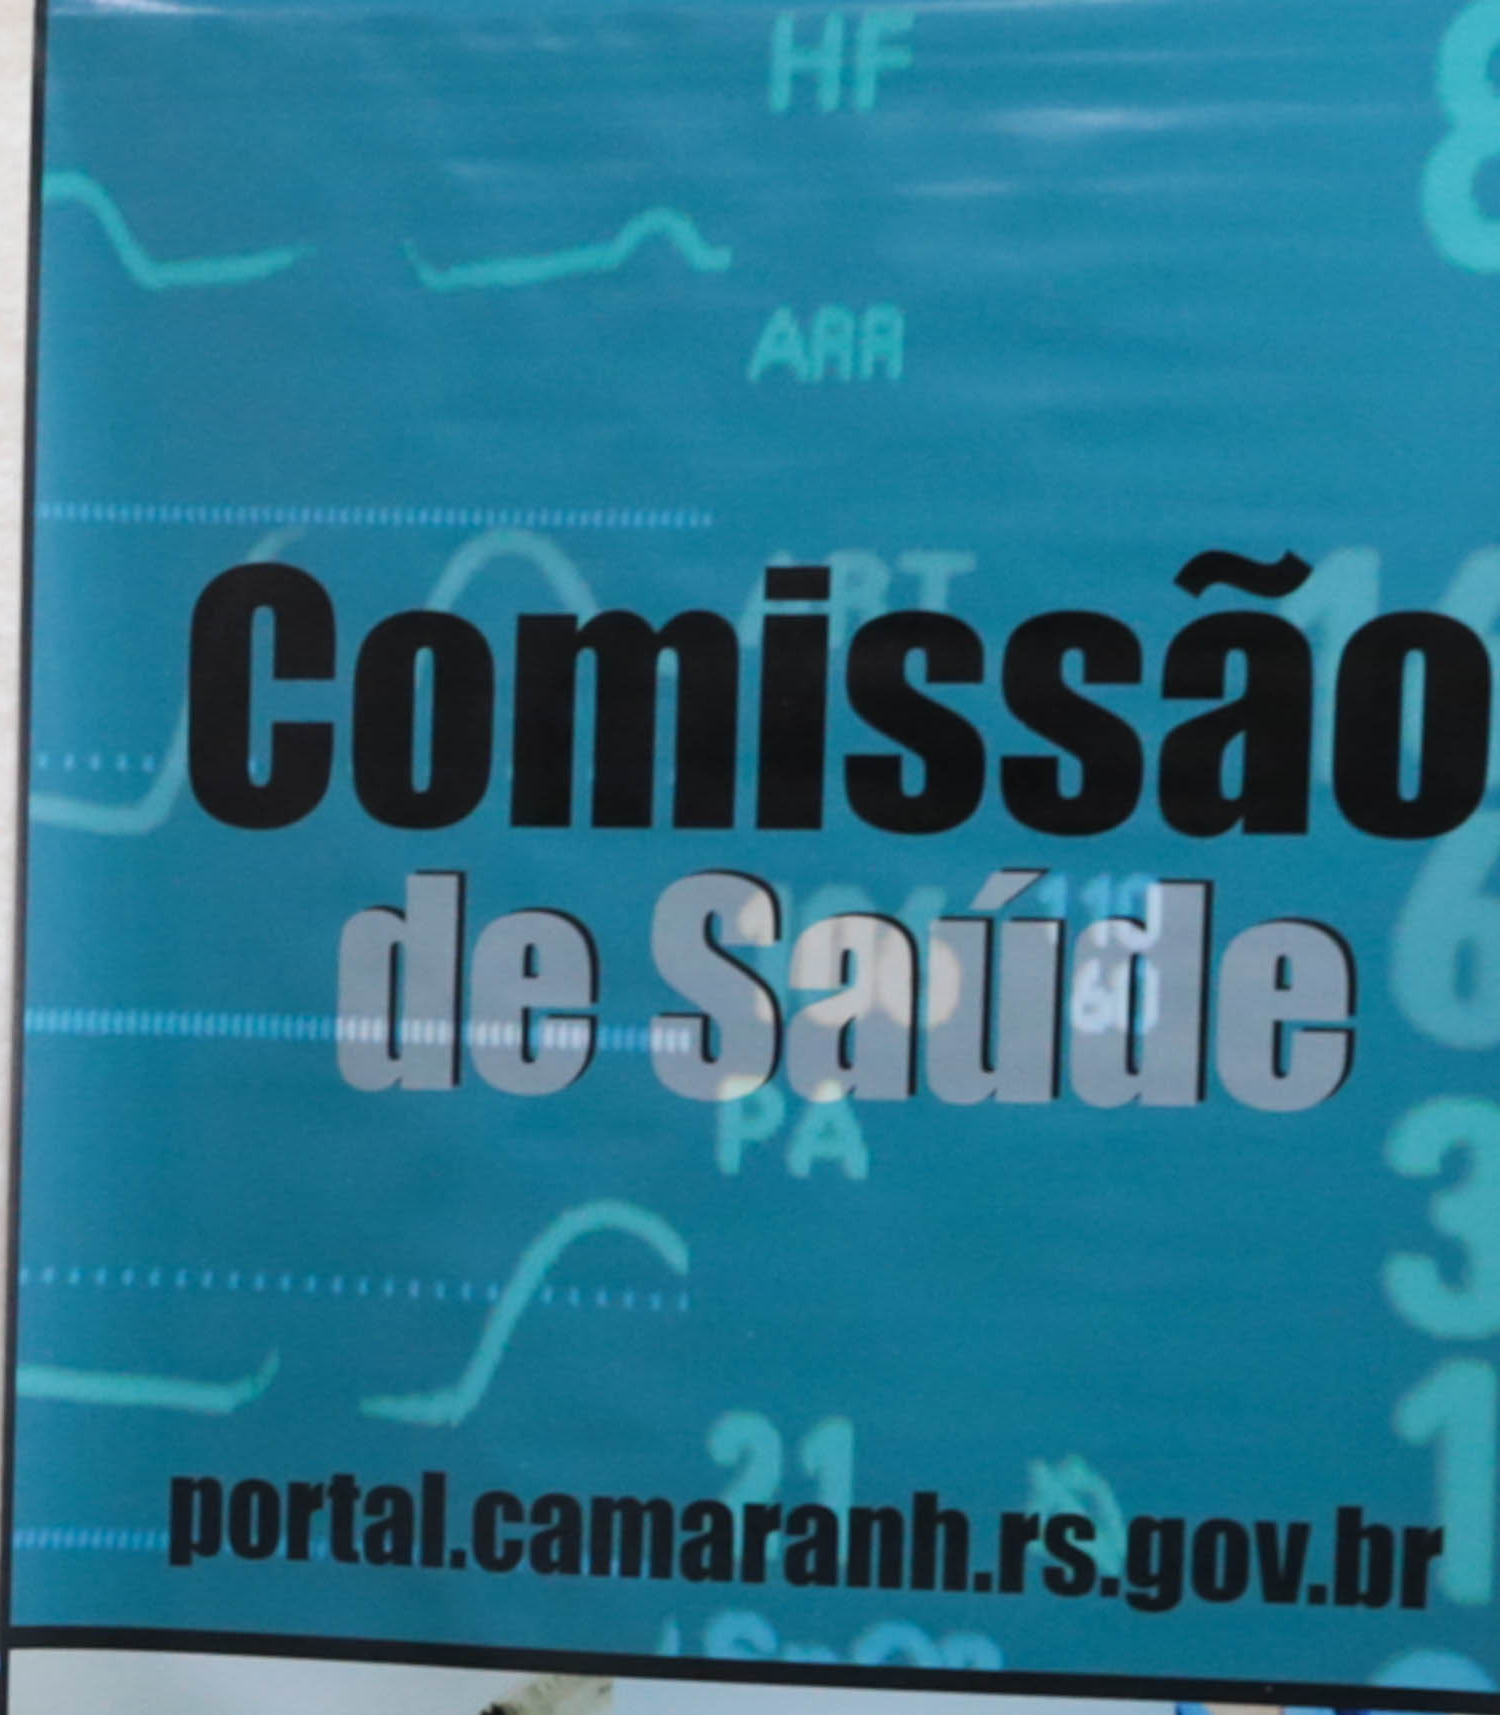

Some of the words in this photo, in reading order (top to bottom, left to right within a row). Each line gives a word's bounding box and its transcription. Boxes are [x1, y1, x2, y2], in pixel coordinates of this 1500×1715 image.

[767, 9, 913, 114] HF
[748, 306, 905, 382] ARR
[188, 550, 1493, 840] Comissão
[336, 868, 600, 1097] de
[649, 866, 1358, 1111] Saúde
[715, 1076, 870, 1181] PA
[168, 1471, 1445, 1613] portal.camaranh.rs.gov.br
